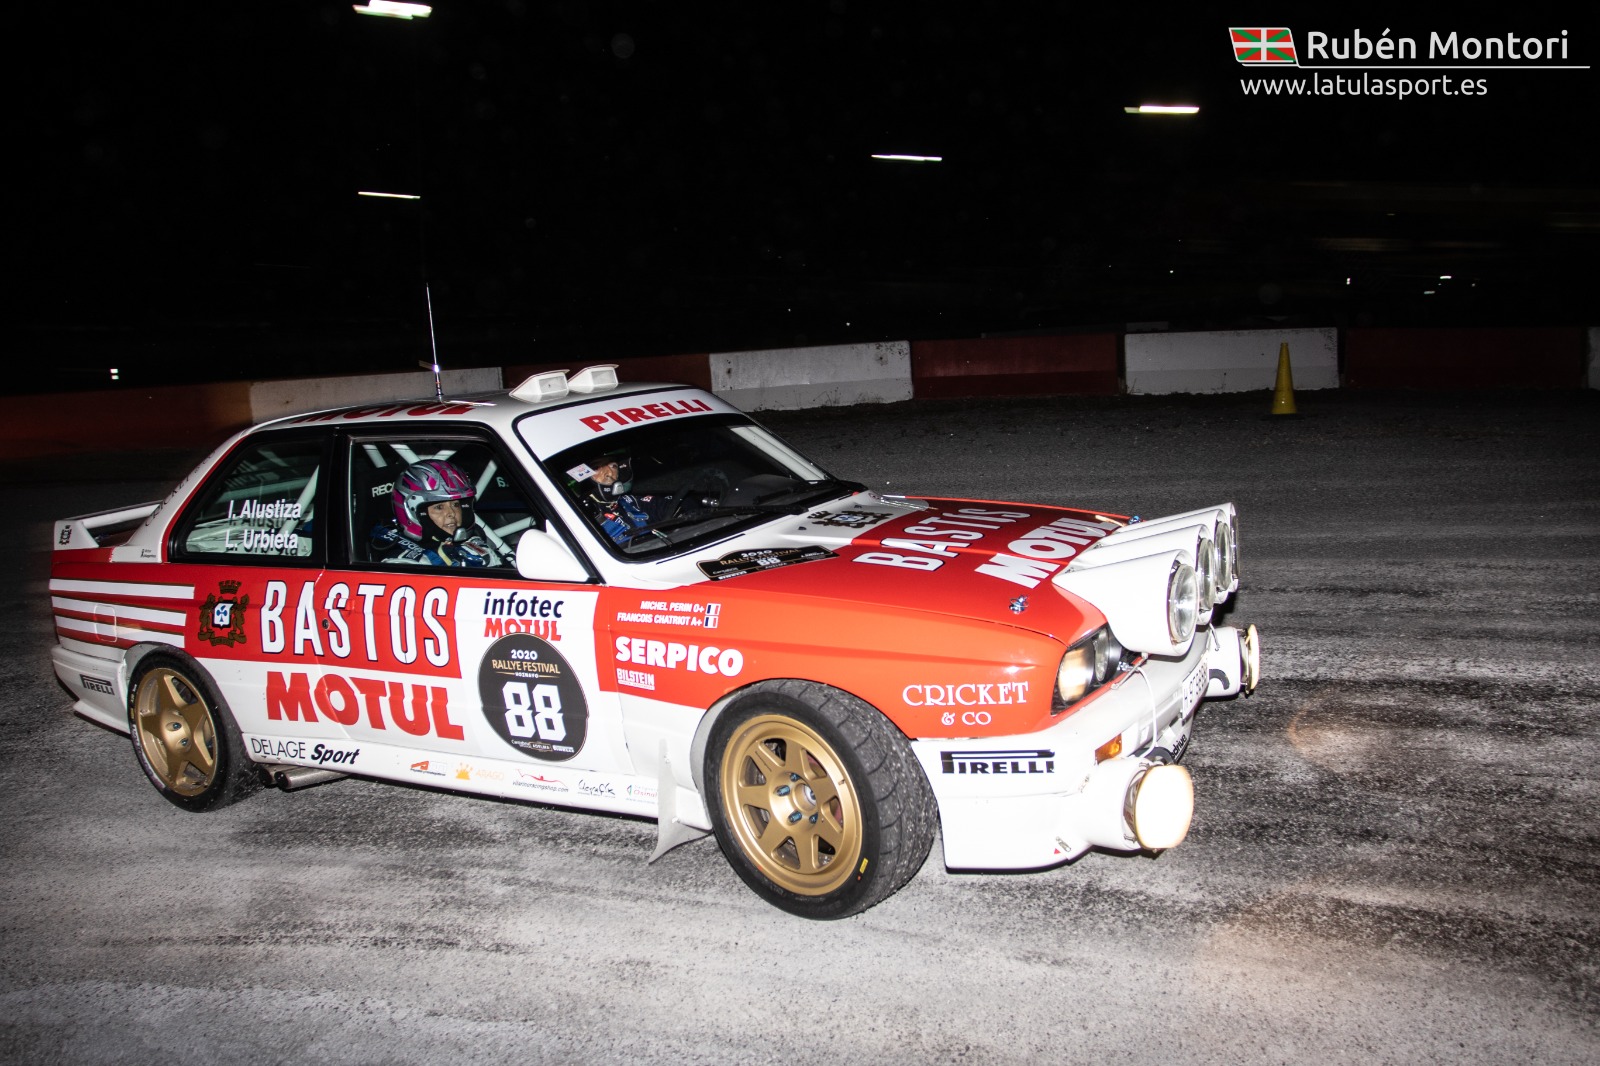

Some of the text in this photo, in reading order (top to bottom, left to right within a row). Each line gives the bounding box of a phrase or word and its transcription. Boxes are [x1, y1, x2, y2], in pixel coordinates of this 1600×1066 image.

[579, 399, 713, 432] PIRELLI
[240, 498, 302, 518] Alustiza
[225, 529, 298, 549] L. Urbieta
[974, 517, 1120, 589] MOTUL
[483, 591, 564, 619] infotec
[640, 600, 668, 611] MICHEL
[669, 602, 692, 613] PERIN
[260, 580, 449, 668] BASTOS
[484, 618, 562, 641] MOTUL
[616, 612, 653, 624] FRANCOIS
[654, 614, 690, 626] CHATRIOT
[491, 659, 561, 674] RALLYE FESTIVAL
[510, 649, 538, 660] 2020
[615, 636, 744, 677] SERPICO
[80, 674, 115, 696] PIRELLI
[616, 668, 655, 686] BILSTEIN
[902, 681, 1029, 706] CRICKET
[266, 671, 465, 741] MOTUL
[502, 681, 567, 742] 88
[941, 711, 992, 725] & CO
[251, 737, 360, 765] DELAGE Sport
[940, 749, 1056, 774] PIRELLI
